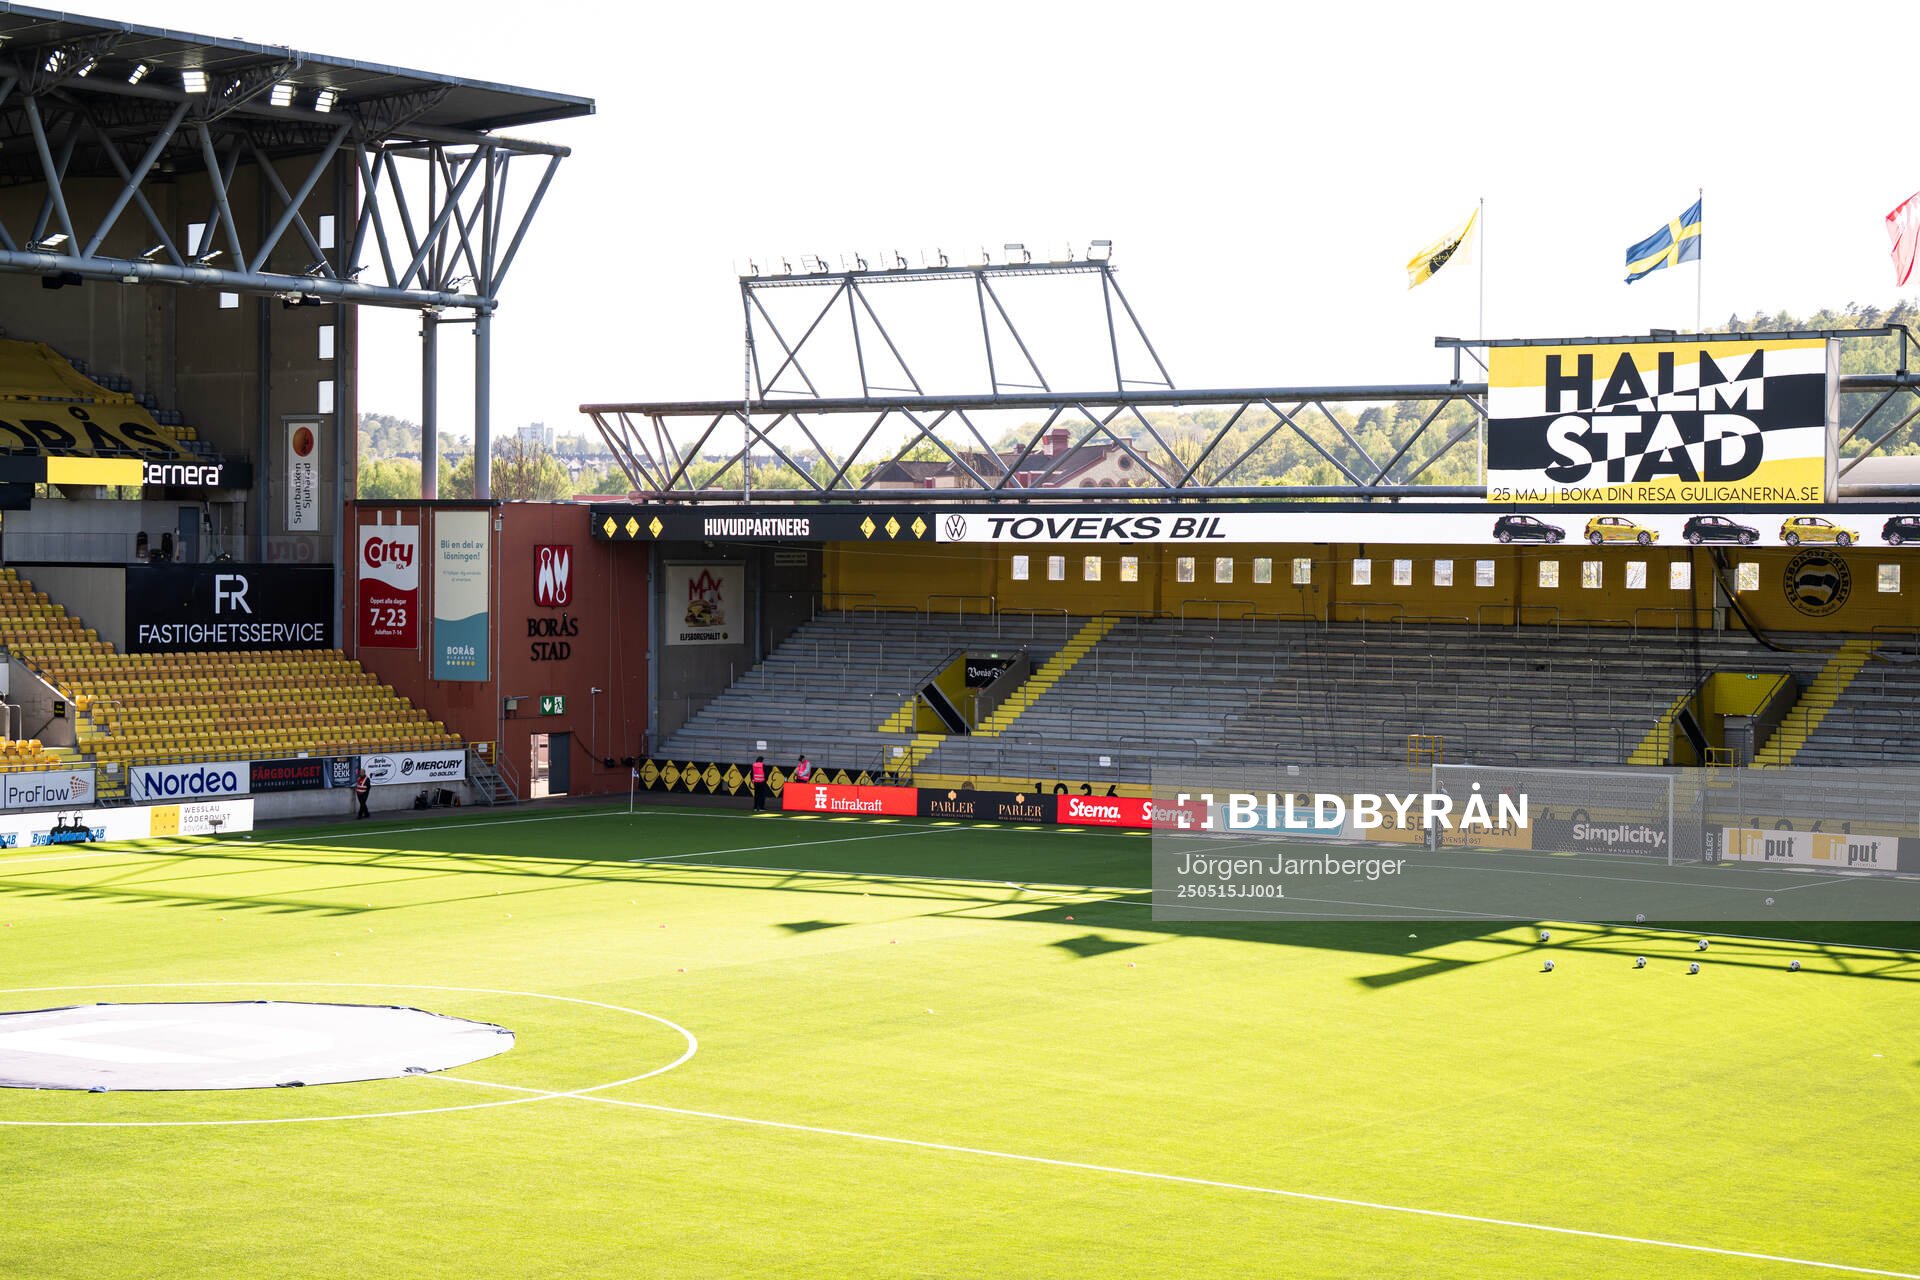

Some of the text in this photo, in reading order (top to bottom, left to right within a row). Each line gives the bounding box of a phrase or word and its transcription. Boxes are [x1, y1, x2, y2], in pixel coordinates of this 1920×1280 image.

[1546, 349, 1764, 412] HALM
[1544, 414, 1764, 483] STAD
[294, 463, 302, 524] Sparbanken
[1493, 486, 1819, 501] 25 MAJ BOKA DIN RESA GULIGANERNA.SE
[704, 518, 810, 536] HUVUDPARTNERS
[987, 517, 1227, 539] TOVEKS BIL
[364, 536, 414, 568] City
[441, 540, 450, 549] Bli
[462, 540, 473, 549] del
[443, 552, 480, 562] lösningen!
[215, 574, 252, 614] FR
[370, 608, 406, 627] 7-23
[527, 612, 578, 637] BORÅS
[139, 622, 324, 644] FASTIGHETSSERVICE
[447, 645, 475, 656] BORÅS
[530, 641, 571, 661] STAD
[252, 765, 321, 780] FÄRGBOLAGET
[334, 762, 350, 770] DEMI
[415, 760, 462, 771] MERCURY
[145, 767, 237, 796] Nordea
[9, 786, 69, 803] ProFlow
[184, 805, 220, 813] WESSLAU
[831, 798, 882, 811] Infrakraft
[931, 800, 974, 813] PARLER
[999, 804, 1041, 816] PARLER
[1069, 798, 1121, 818] Stema.
[1142, 802, 1195, 822] Stema.
[1572, 823, 1666, 847] Simplicity.
[1705, 832, 1713, 861] SELECT
